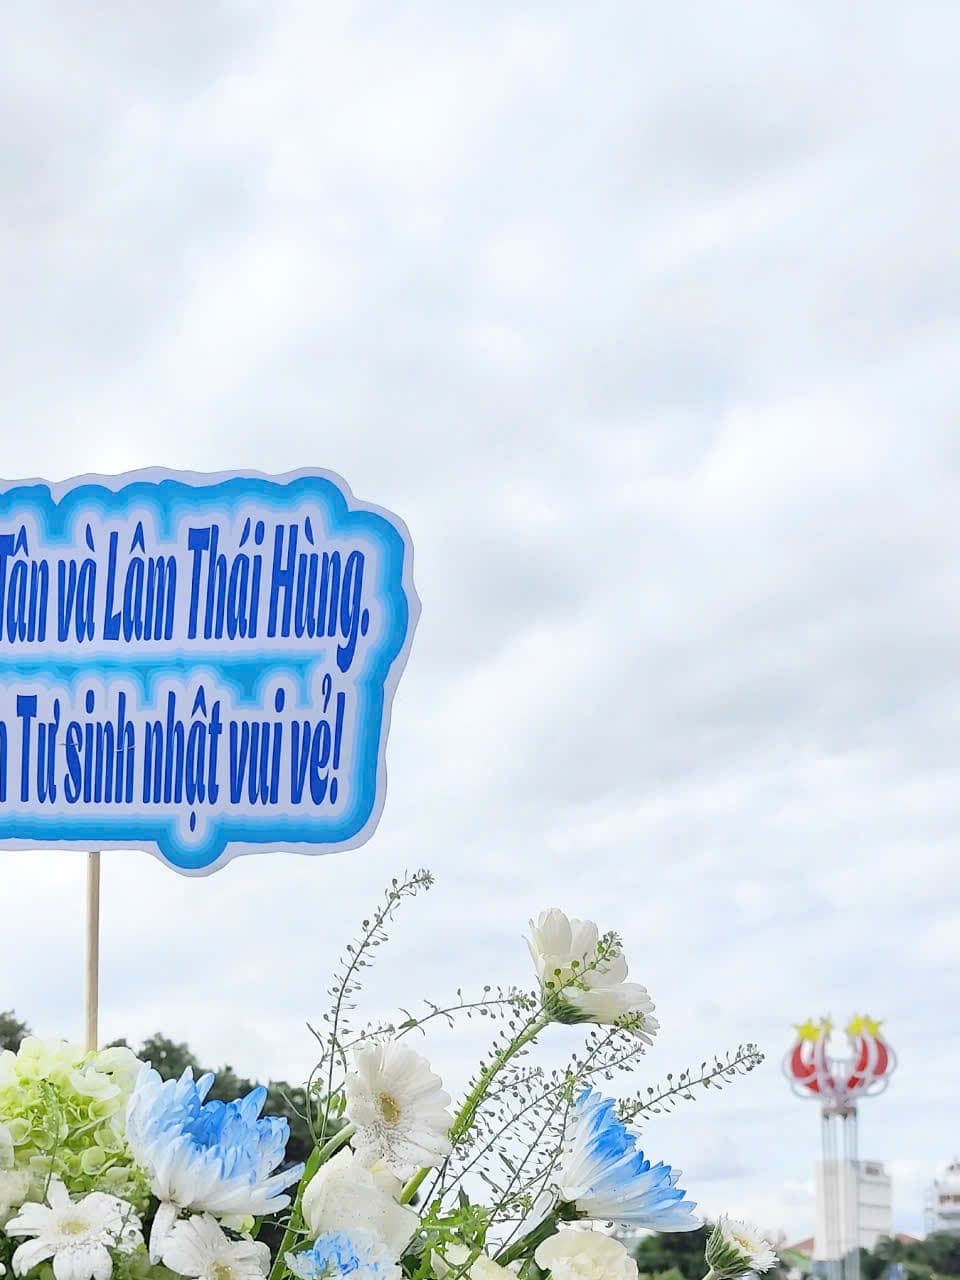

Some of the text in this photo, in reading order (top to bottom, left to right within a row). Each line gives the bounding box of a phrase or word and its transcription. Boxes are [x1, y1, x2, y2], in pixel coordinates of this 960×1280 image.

[57, 523, 97, 644] và
[102, 521, 177, 643] Lâm
[187, 517, 265, 641] Thái
[16, 694, 60, 805] Tư
[62, 689, 135, 805] sinh
[142, 684, 223, 833] nhật
[229, 687, 283, 806] vui
[290, 673, 346, 806] vẻ!
